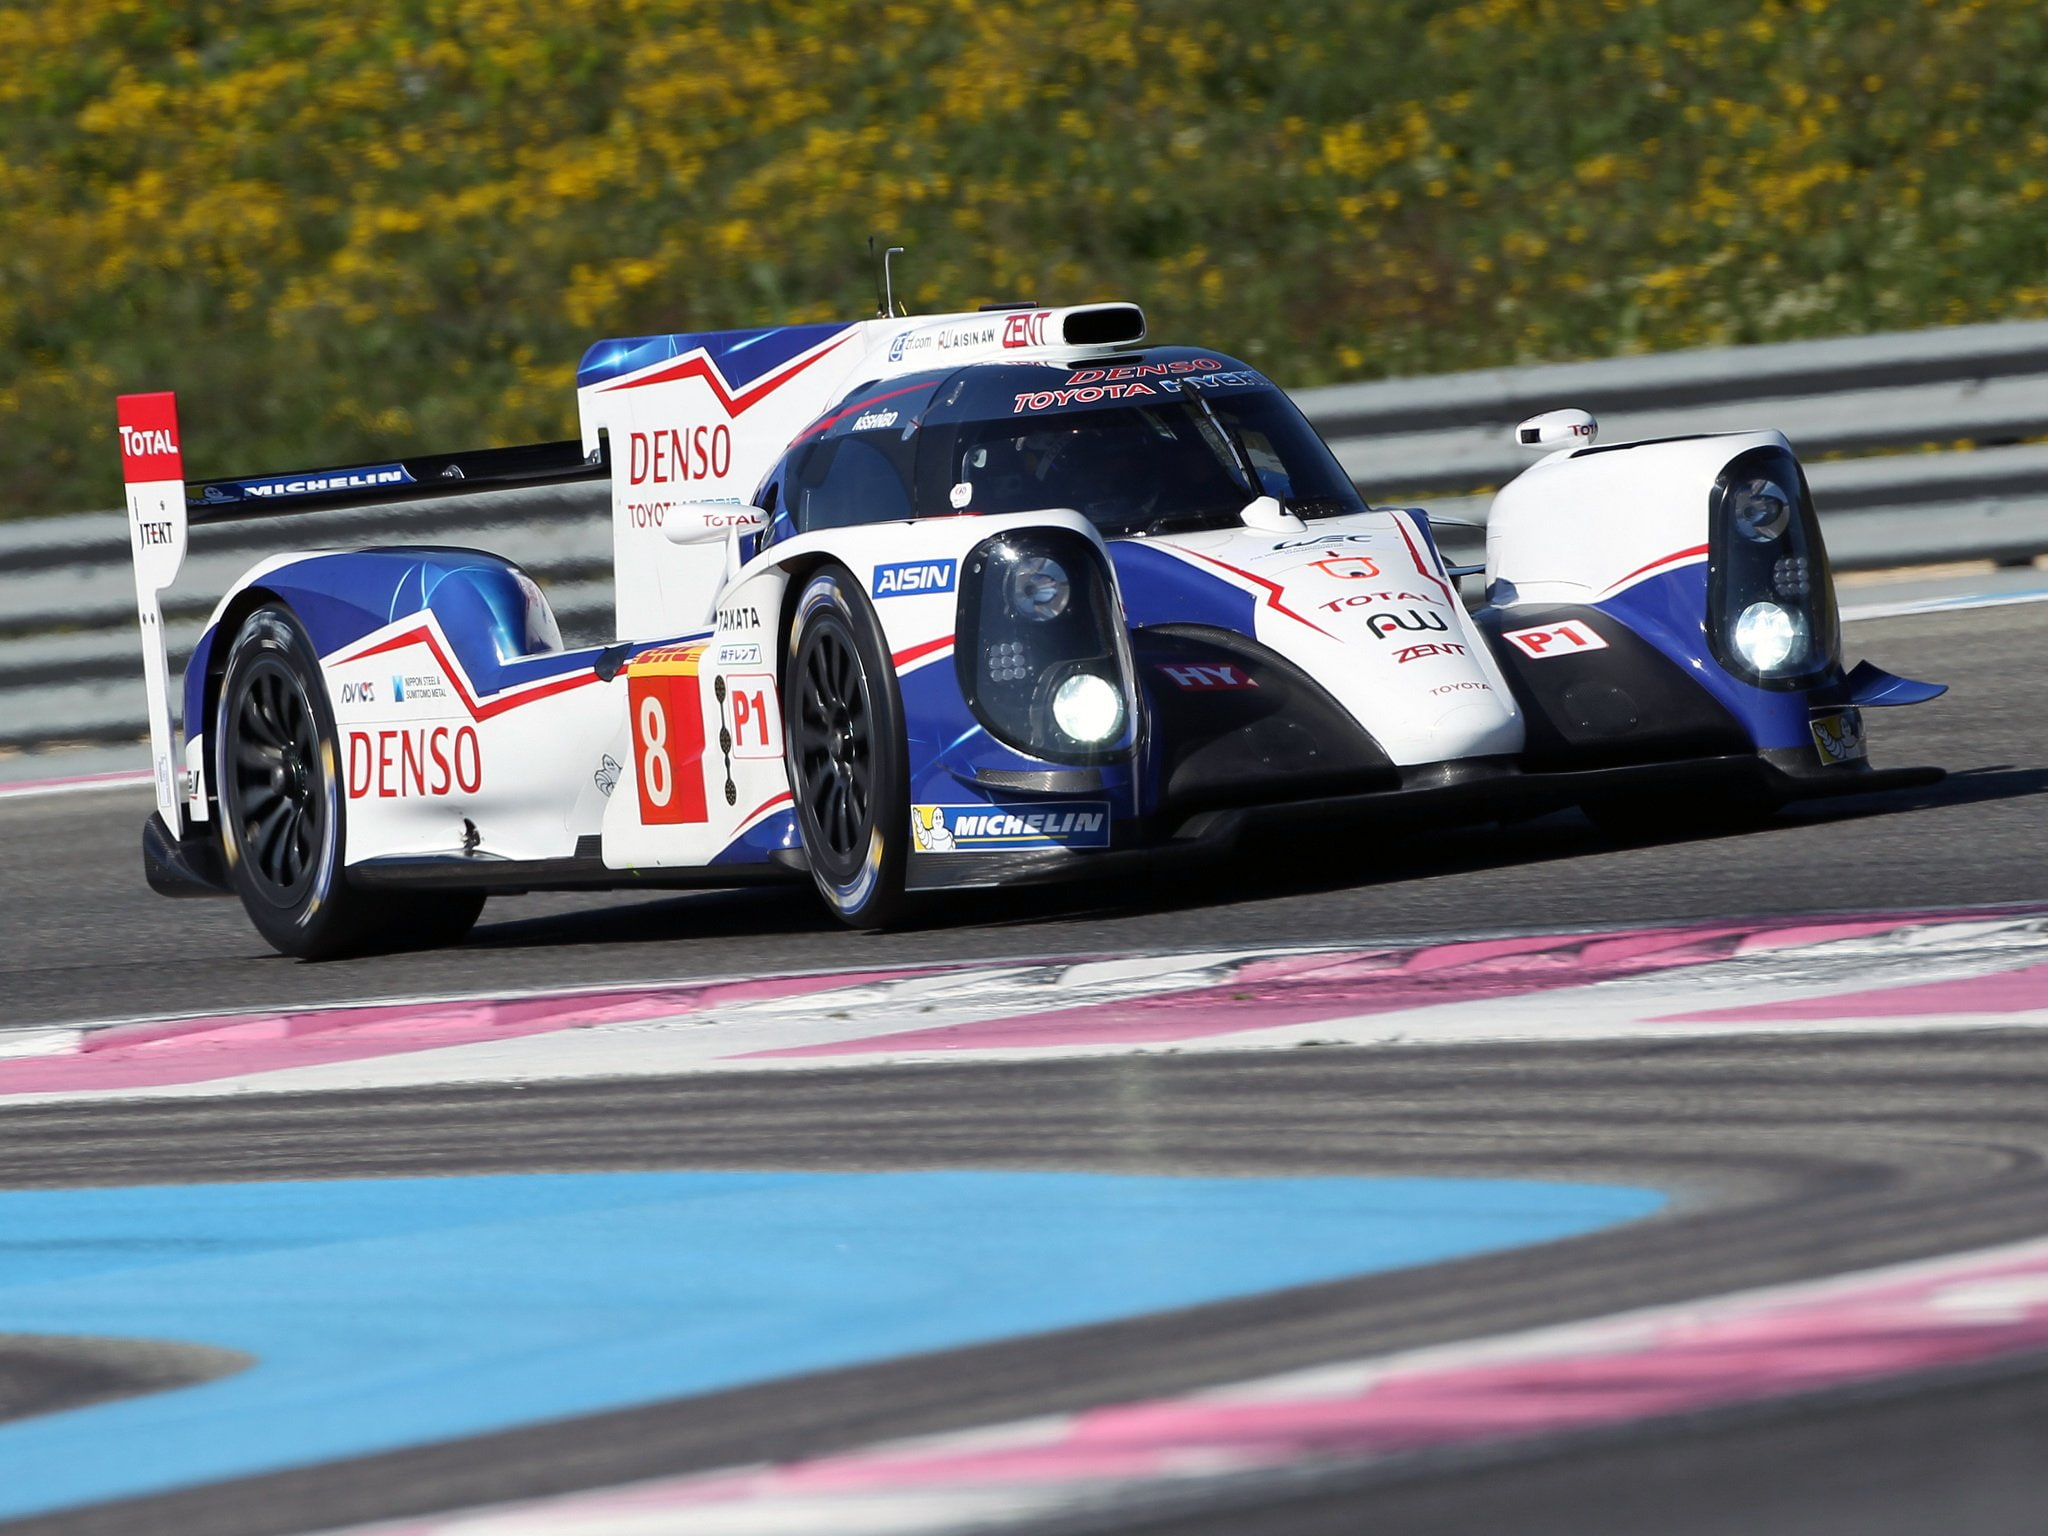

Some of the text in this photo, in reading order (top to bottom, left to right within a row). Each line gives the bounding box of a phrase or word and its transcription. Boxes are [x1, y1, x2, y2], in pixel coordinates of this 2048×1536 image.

[953, 332, 979, 347] AISIN
[981, 328, 996, 343] AW
[1002, 312, 1052, 348] ZENT
[1065, 358, 1222, 386] DENSO
[1013, 382, 1157, 414] TOYOTA
[119, 425, 179, 457] TOTAL
[630, 424, 731, 485] DENSO
[244, 470, 402, 497] MICHELIN
[703, 514, 762, 527] TOTAL
[139, 521, 173, 551] JTEKT
[877, 565, 951, 593] AISIN
[1318, 591, 1445, 613] TOTAL
[718, 606, 761, 631] TAKATA
[1391, 643, 1466, 664] ZENT
[1516, 625, 1588, 654] P1
[1163, 667, 1238, 686] HY
[1430, 682, 1492, 696] TOYOTA
[732, 690, 769, 747] P1
[349, 725, 481, 799] DENSO
[640, 696, 673, 808] 8
[954, 813, 1104, 836] MICHELIN
